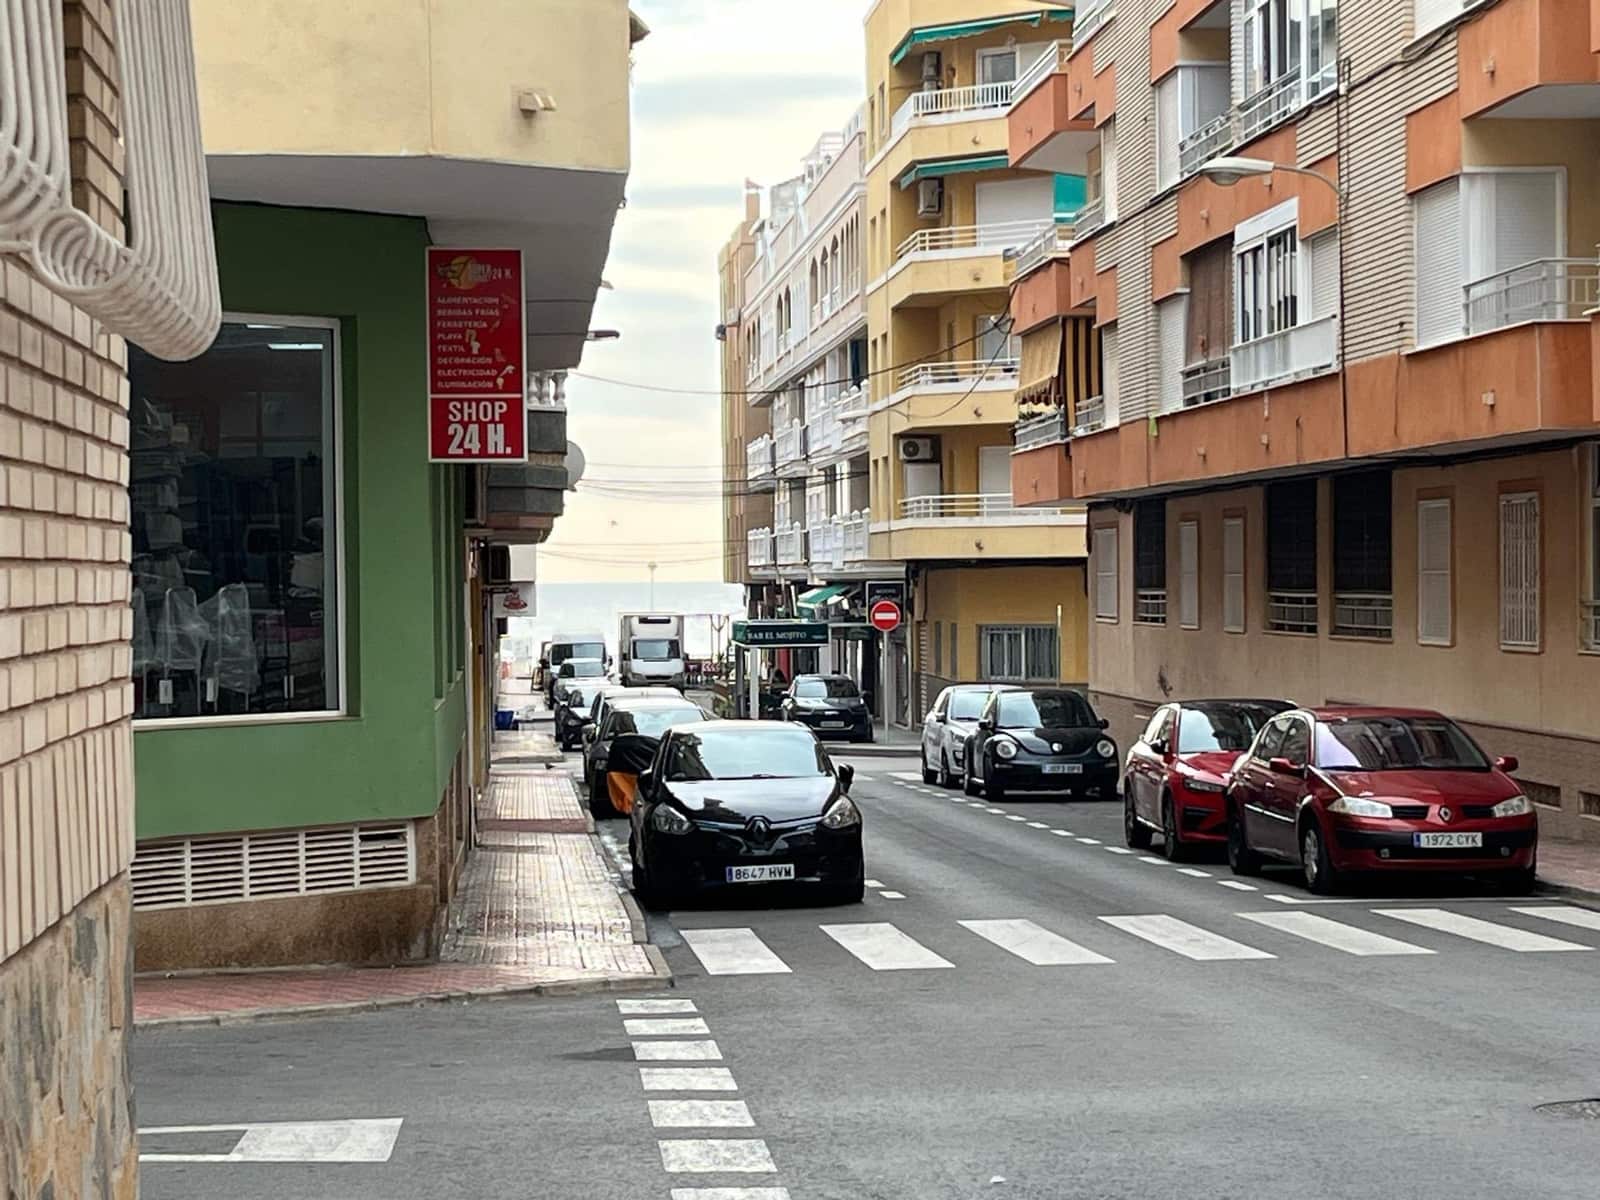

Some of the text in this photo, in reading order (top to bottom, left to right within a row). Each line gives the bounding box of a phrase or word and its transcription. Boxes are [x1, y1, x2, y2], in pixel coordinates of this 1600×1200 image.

[437, 333, 463, 341] PLAYA
[437, 345, 466, 353] TEXTIL
[437, 368, 498, 377] ELECTRICIDAD
[448, 401, 508, 423] SHOP
[447, 423, 512, 455] 24 H.
[748, 631, 764, 640] BAR
[765, 631, 775, 640] EL
[776, 631, 807, 641] MOJITO
[1424, 834, 1453, 846] 1972
[735, 868, 765, 880] 8647
